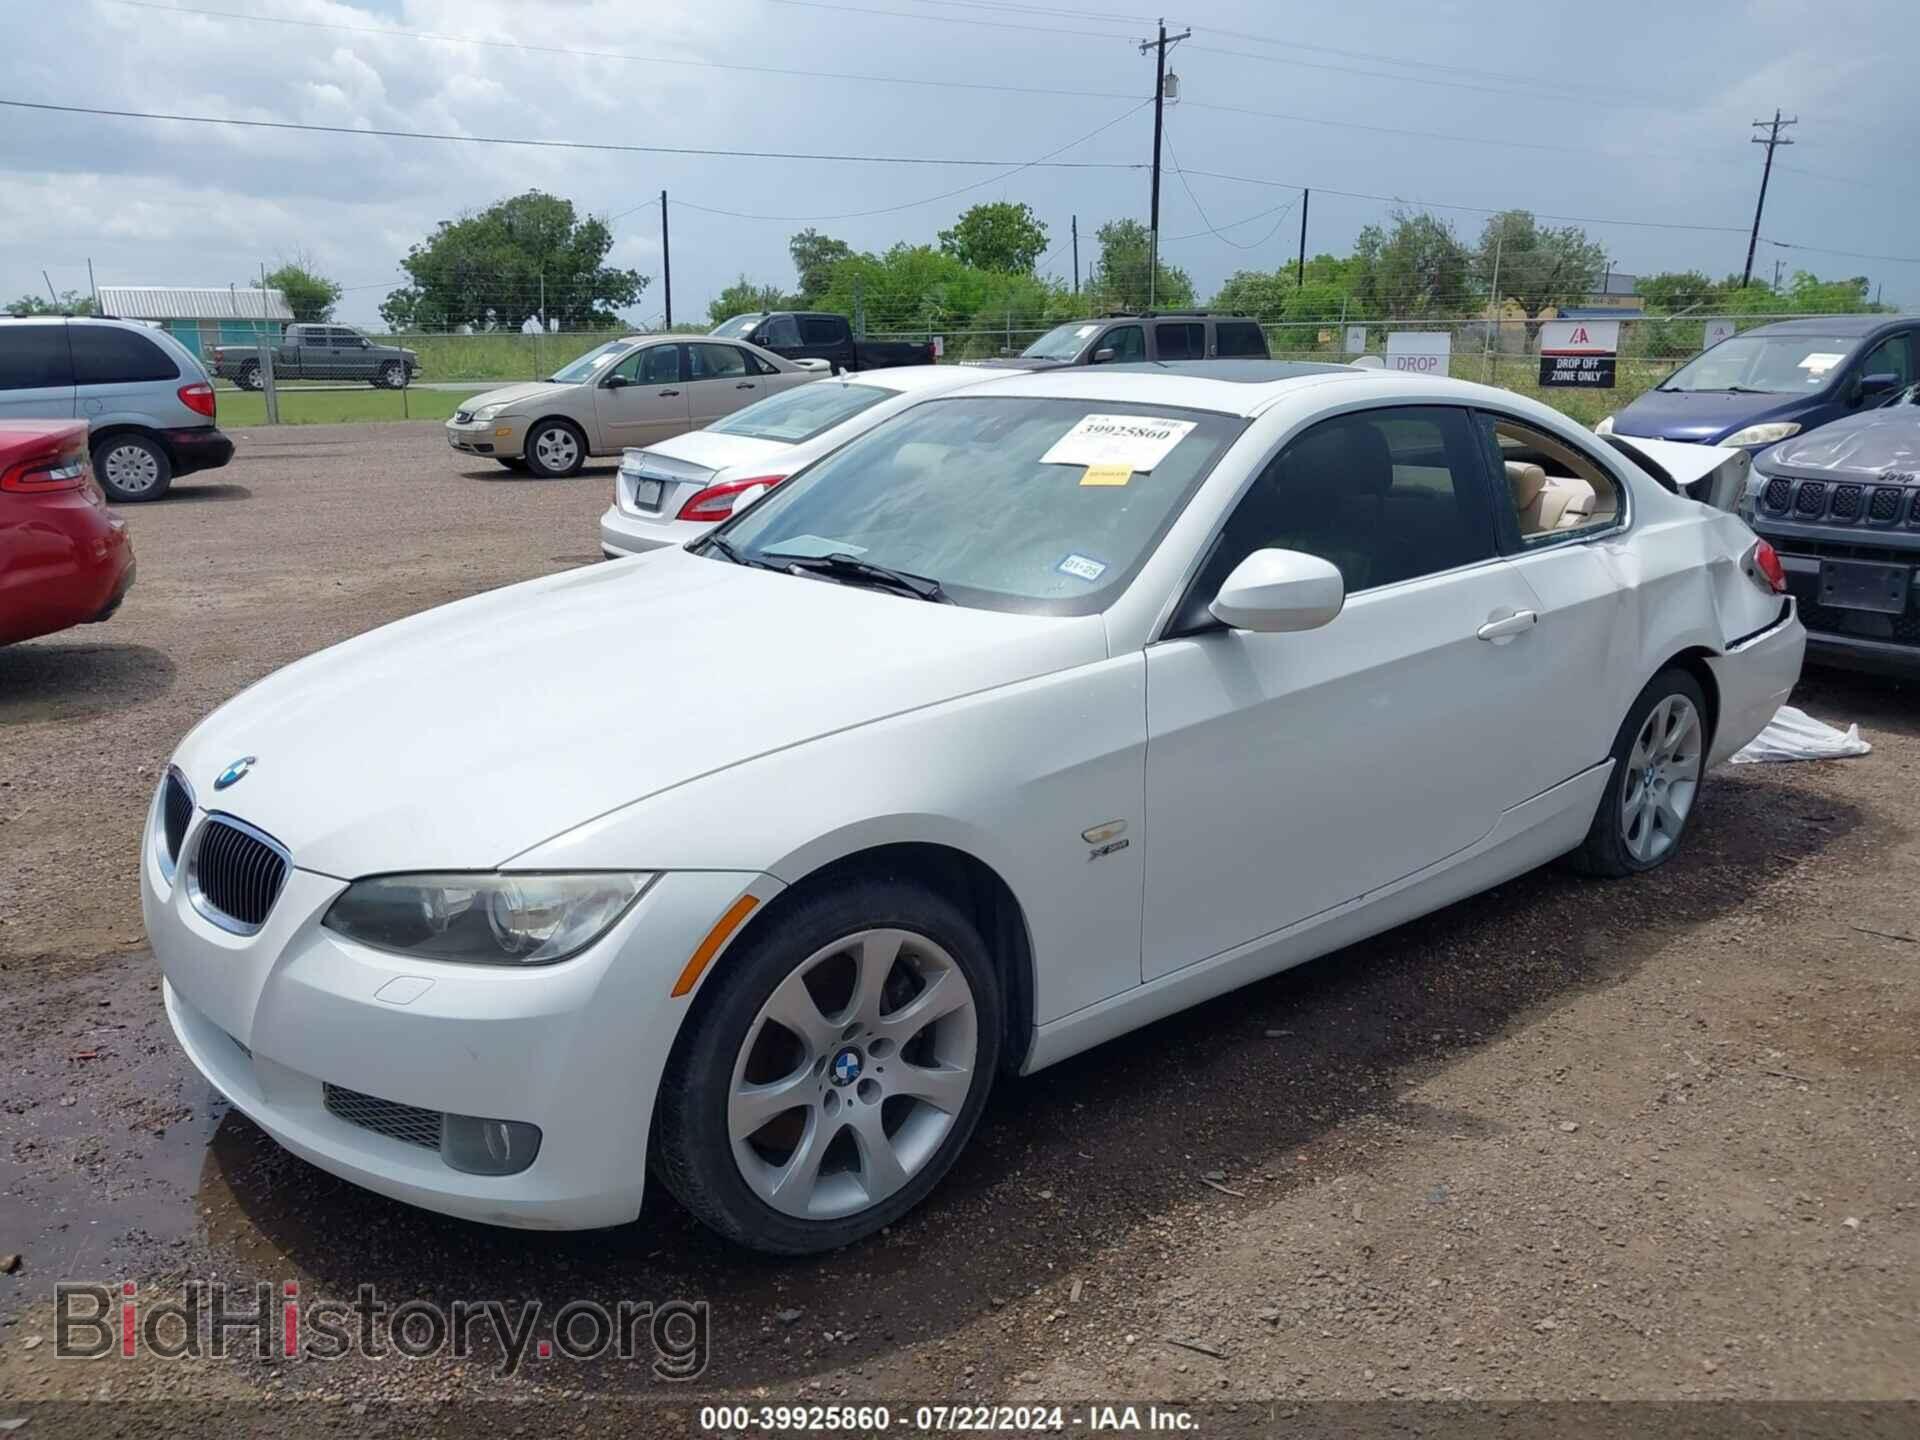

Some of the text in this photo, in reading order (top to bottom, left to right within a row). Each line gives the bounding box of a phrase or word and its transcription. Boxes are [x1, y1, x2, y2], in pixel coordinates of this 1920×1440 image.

[1397, 357, 1438, 371] DROP
[1556, 358, 1600, 369] DROP OFF
[1552, 370, 1602, 382] ZONE ONLY
[1080, 422, 1171, 440] 39925860
